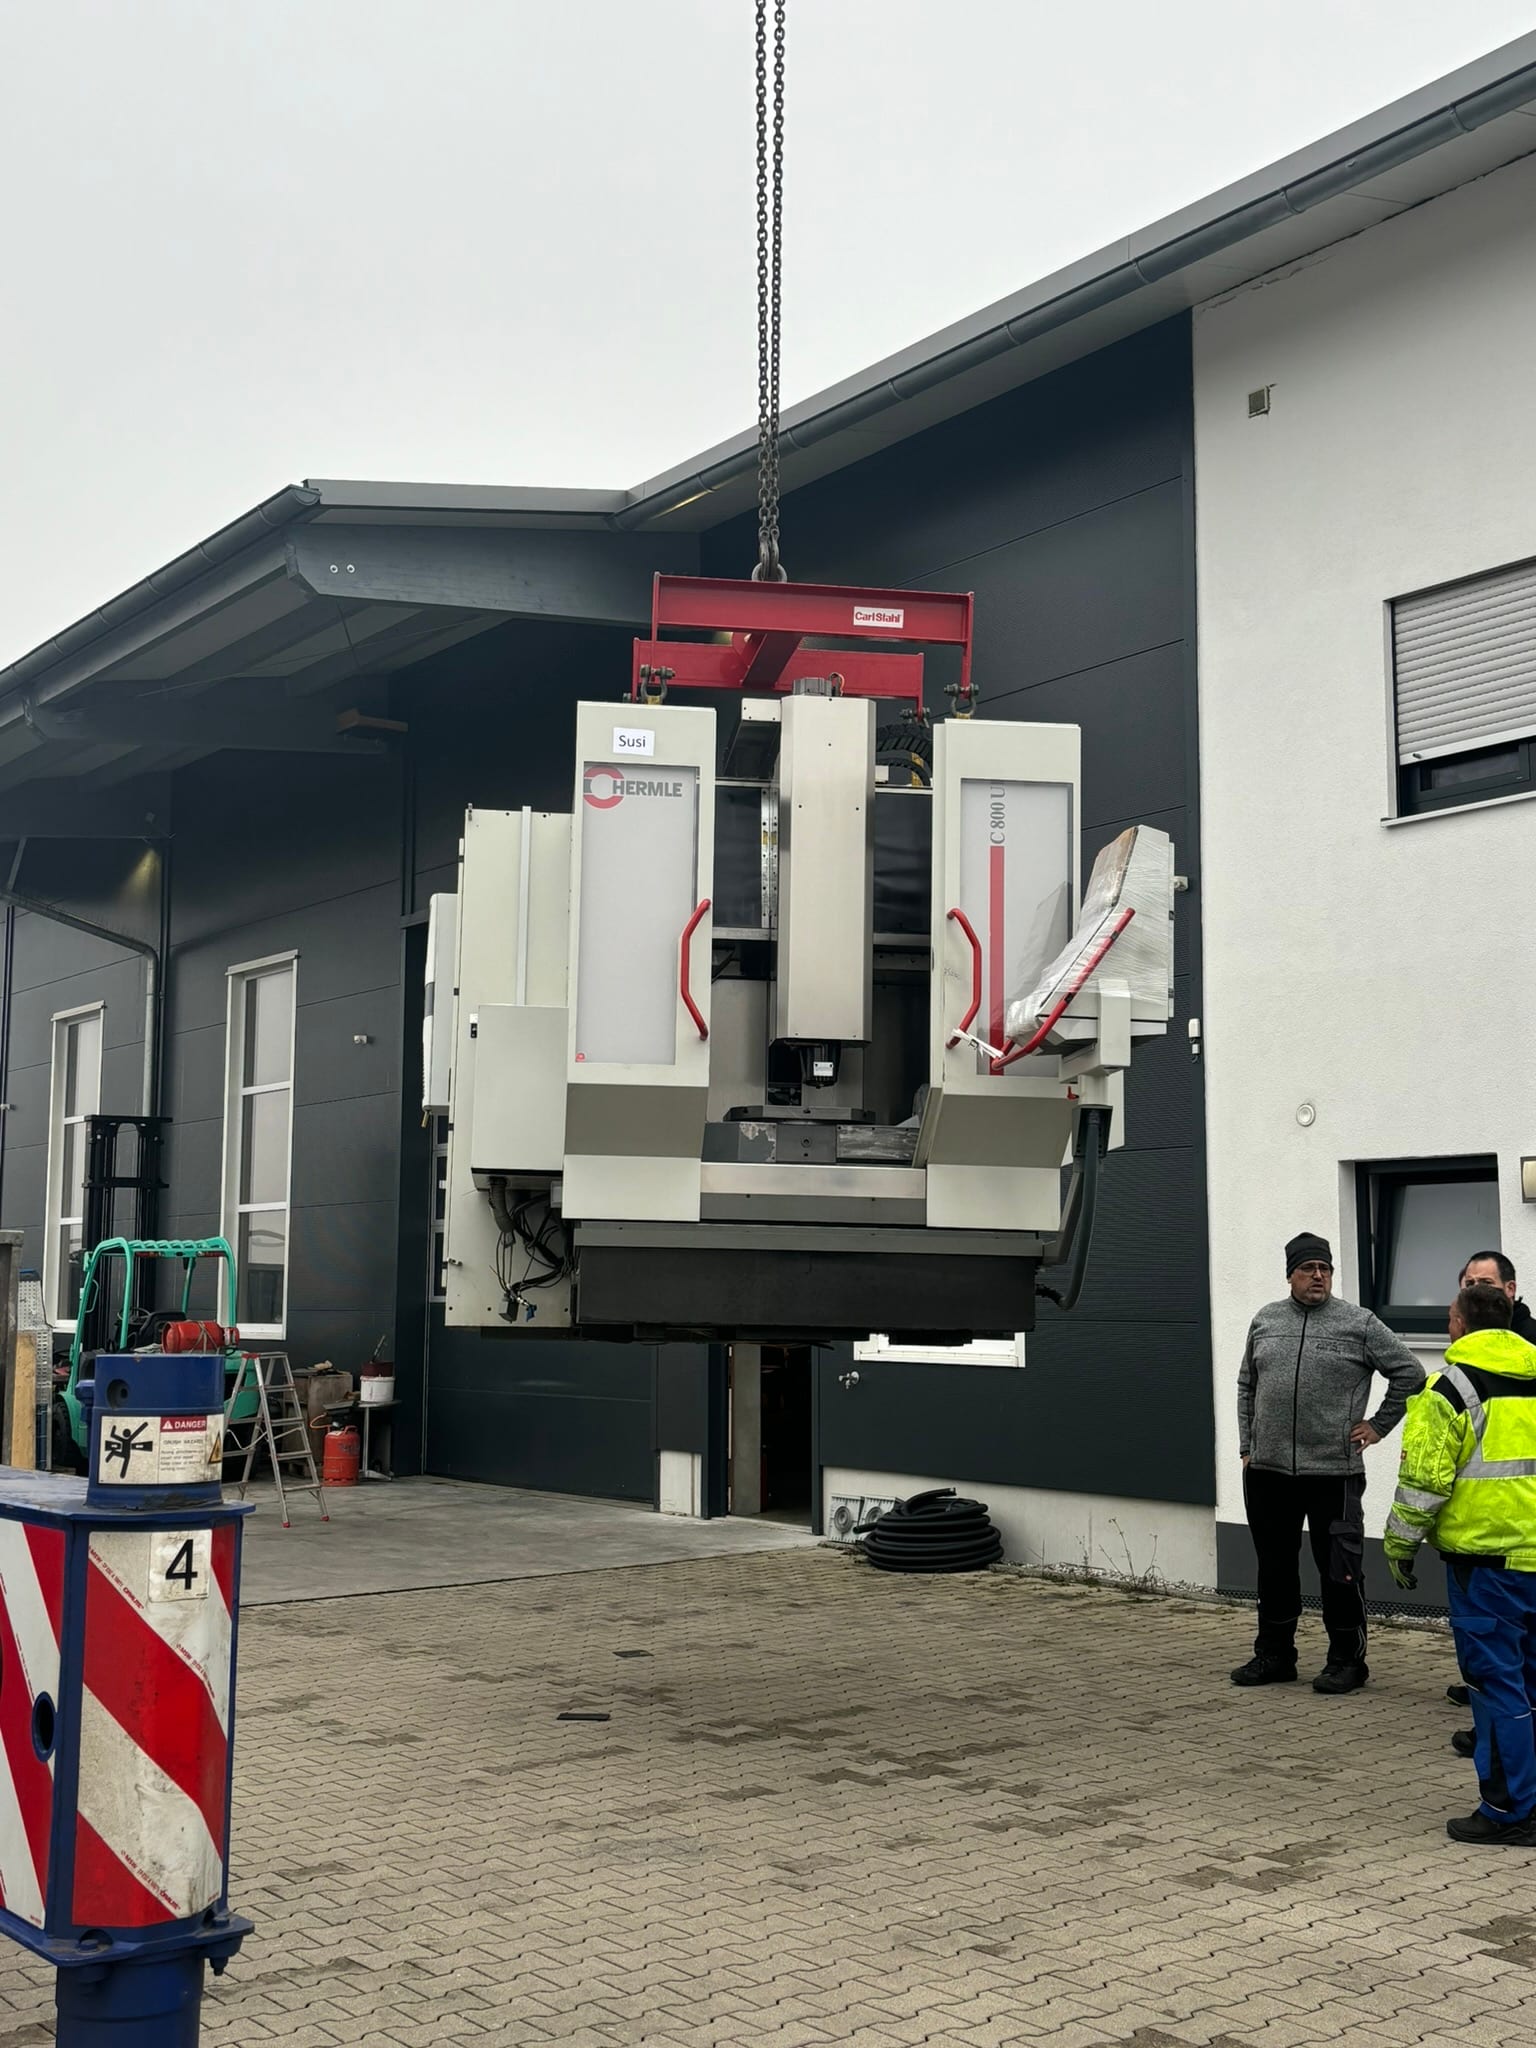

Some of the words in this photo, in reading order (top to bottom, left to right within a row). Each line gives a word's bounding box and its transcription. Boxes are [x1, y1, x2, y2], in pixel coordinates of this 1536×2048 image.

[618, 735, 646, 748] Susi
[613, 780, 683, 797] HERMLE
[990, 802, 1005, 829] 800
[990, 832, 1005, 844] C
[174, 1420, 206, 1429] DANGER
[165, 1538, 198, 1590] 4
